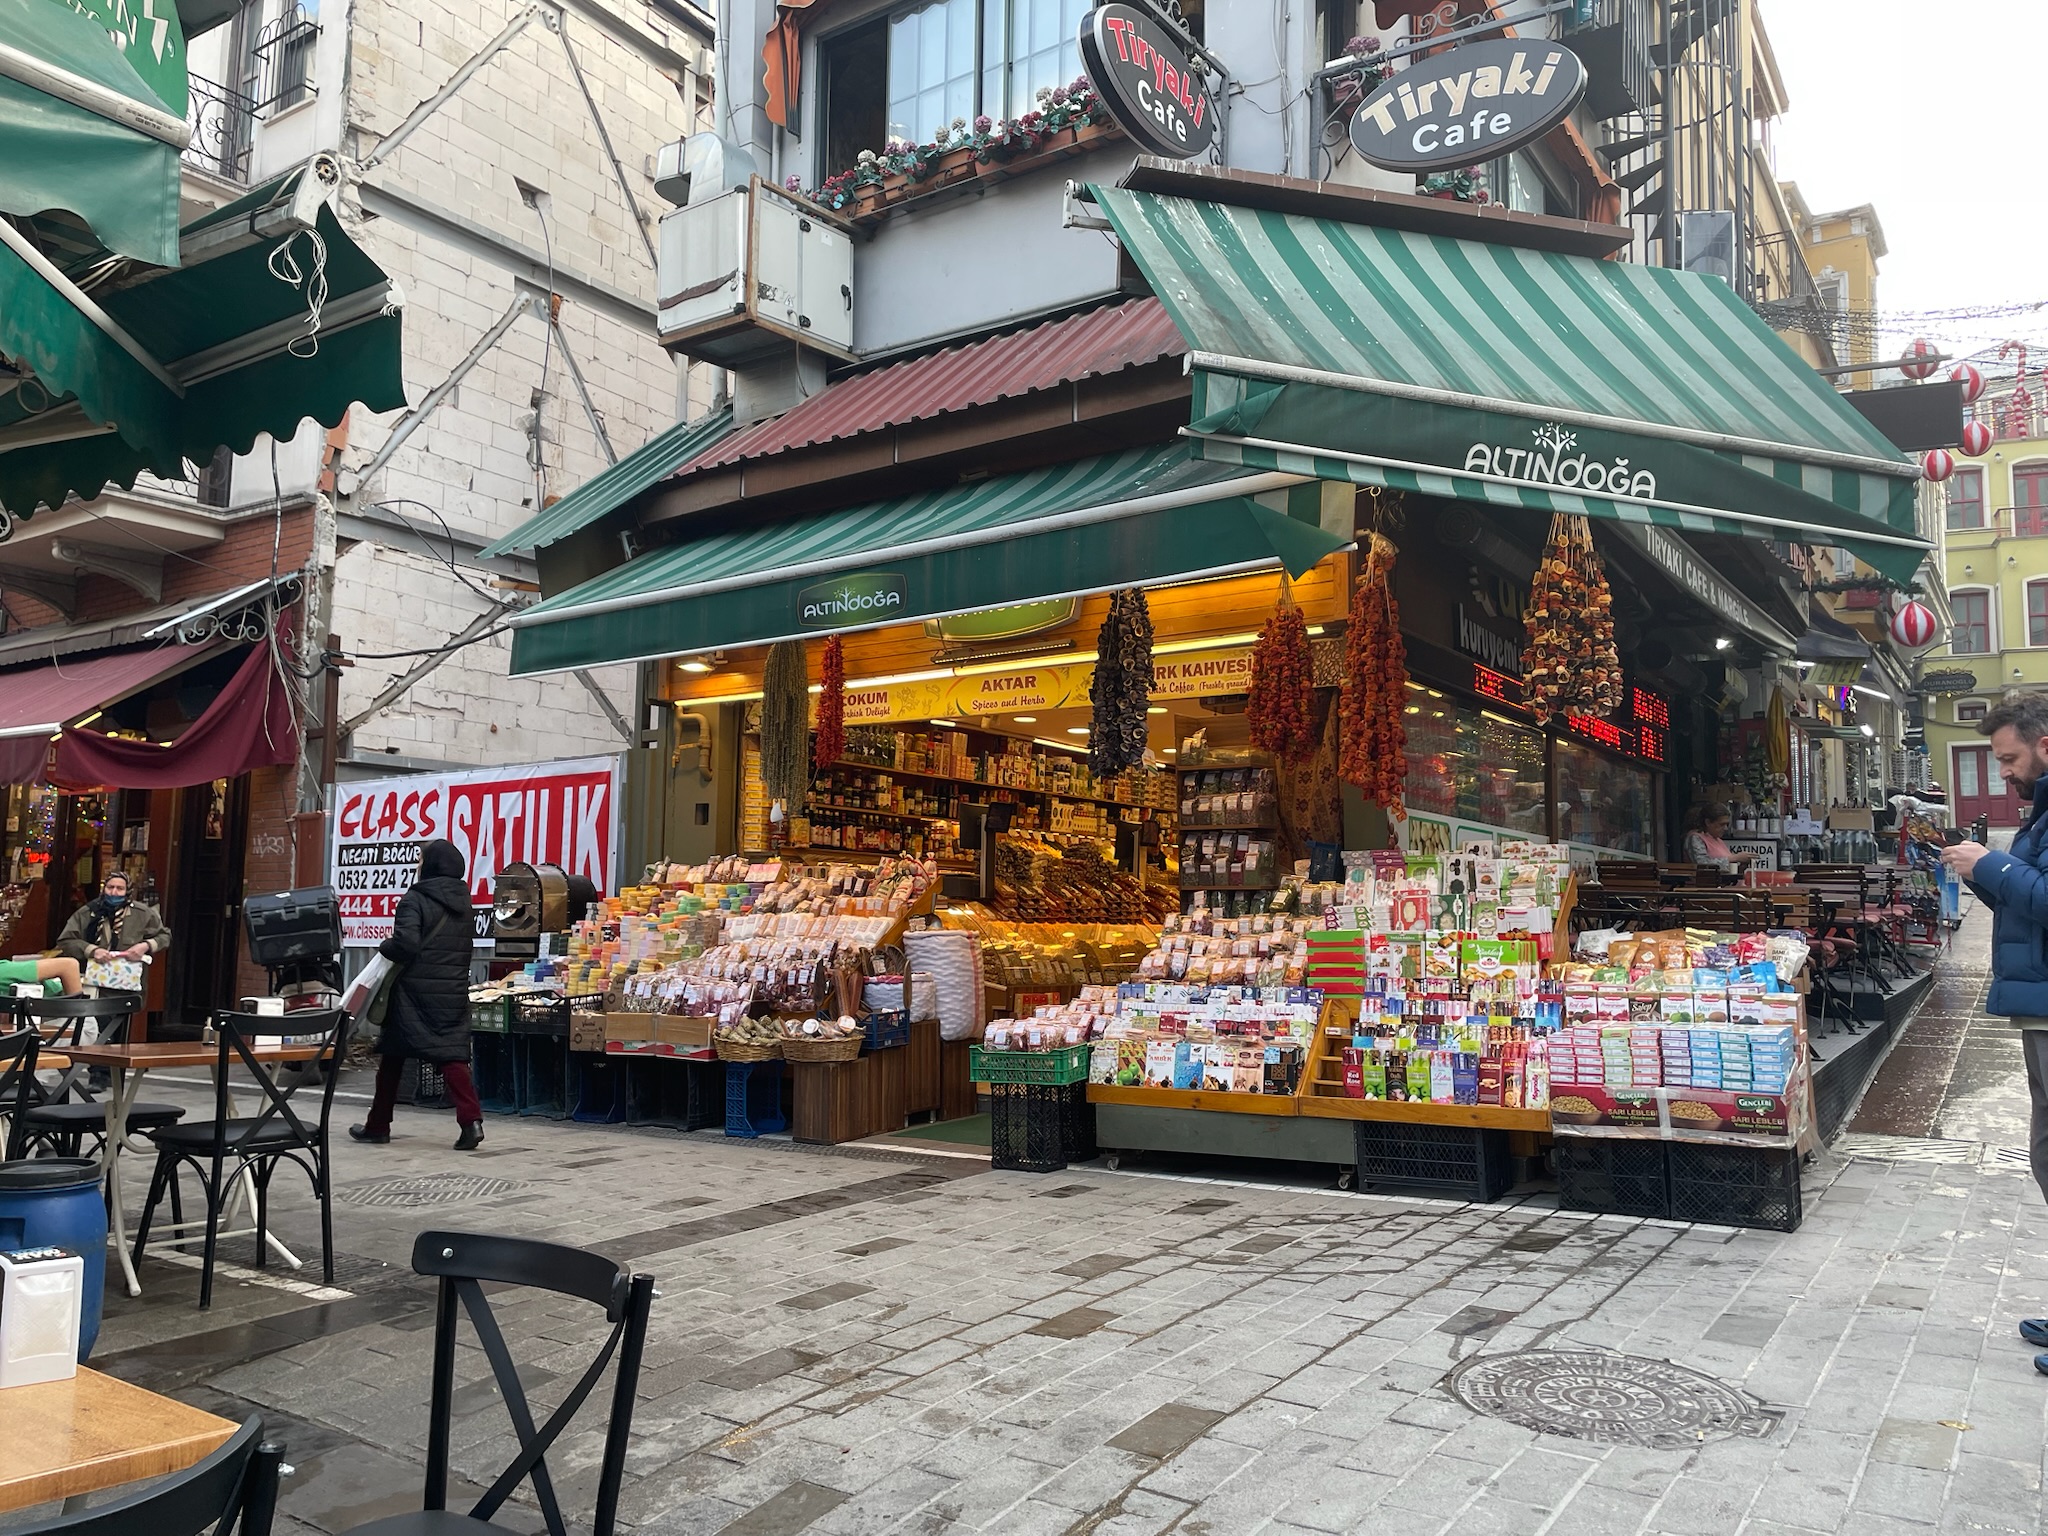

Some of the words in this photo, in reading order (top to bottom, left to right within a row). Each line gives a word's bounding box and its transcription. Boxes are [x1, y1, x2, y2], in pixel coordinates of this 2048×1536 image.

[1107, 17, 1206, 129] Tiryaki
[1360, 52, 1562, 136] Tiryaki
[1137, 80, 1187, 142] Cafe
[1412, 109, 1512, 154] Cafe
[1644, 525, 1683, 579] TİRYAKİ
[1685, 560, 1708, 599] CAFE
[1182, 653, 1252, 677] KAHVESİ
[981, 675, 1037, 692] AKTAR
[1169, 681, 1195, 694] Coffee
[843, 691, 888, 706] OKUM
[972, 699, 999, 711] Spices
[1001, 697, 1018, 707] and
[1020, 695, 1046, 706] Herbs
[865, 706, 891, 718] Delight
[340, 789, 440, 840] CLASS
[339, 870, 367, 889] 0532
[372, 868, 396, 889] 224
[340, 896, 373, 915] 444
[1631, 1002, 1652, 1012] Salep
[1346, 1077, 1361, 1085] Rose
